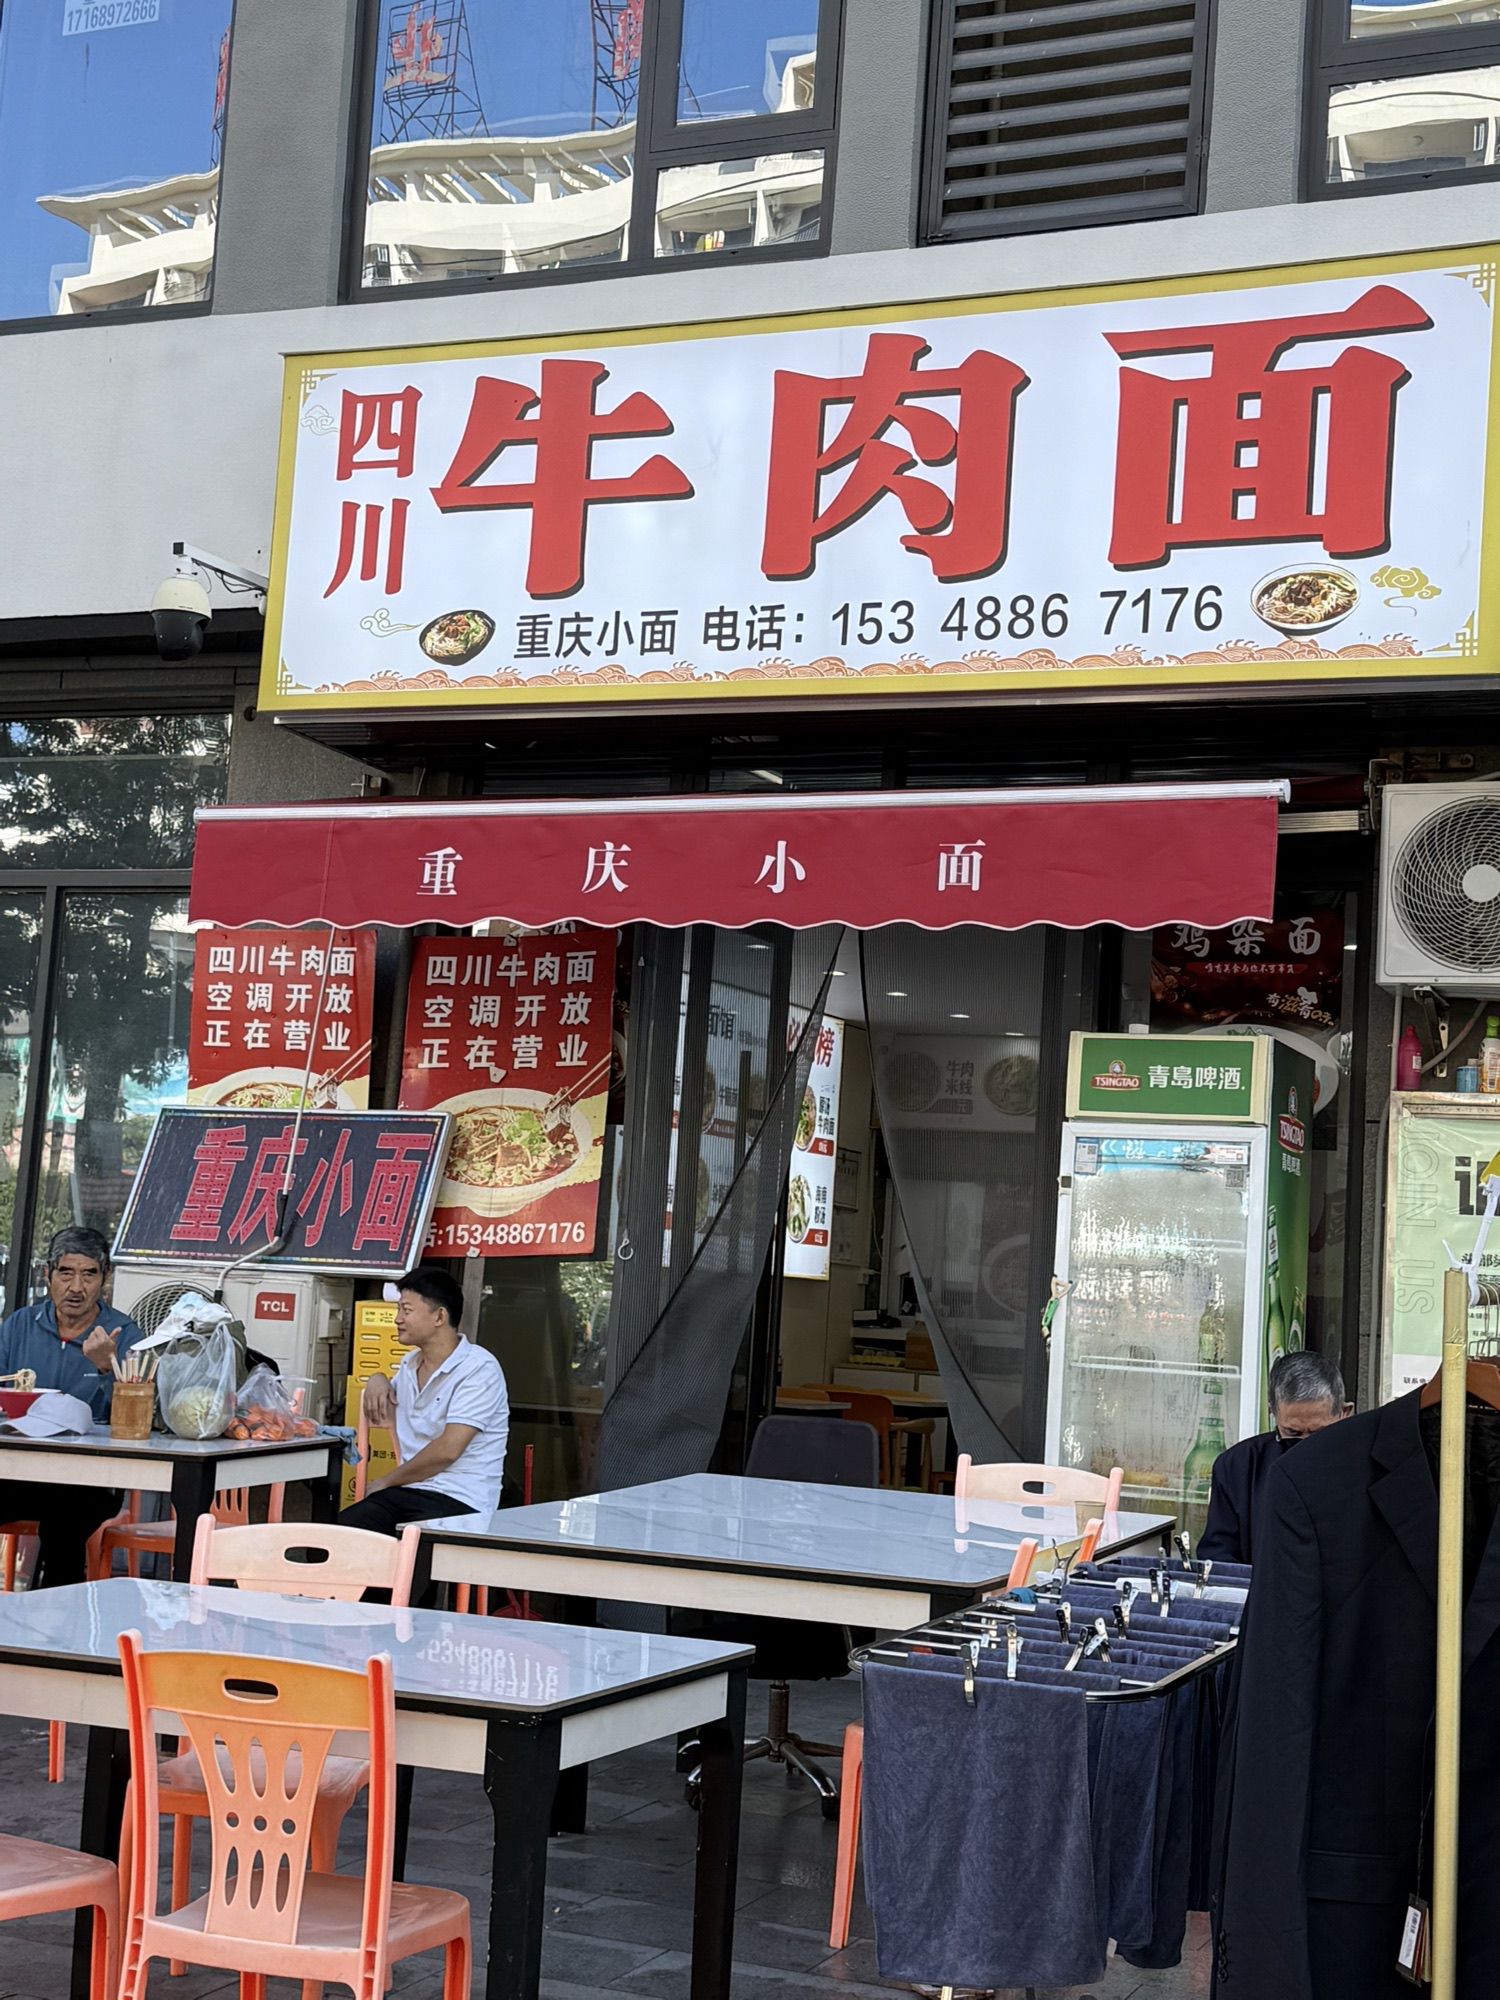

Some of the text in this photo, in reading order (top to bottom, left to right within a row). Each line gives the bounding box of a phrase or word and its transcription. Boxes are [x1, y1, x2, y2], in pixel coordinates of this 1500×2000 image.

[429, 285, 1434, 599] 牛肉面
[324, 385, 422, 598] 四川
[513, 608, 677, 660] 重庆小面
[831, 601, 915, 645] 153
[940, 593, 1070, 641] 4886
[1100, 584, 1224, 635] 7176
[417, 839, 986, 897] 重庆小面
[208, 945, 358, 978] 四川牛肉面
[426, 951, 597, 987] 四川牛肉面
[206, 981, 353, 1015] 空调开放
[423, 990, 591, 1030] 空调开放
[203, 1018, 351, 1053] 正在营业
[418, 1034, 588, 1072] 正在营业
[1094, 1076, 1140, 1088] TSINGTAO
[170, 1125, 434, 1252] 重庆小面
[260, 1300, 290, 1313] TCL
